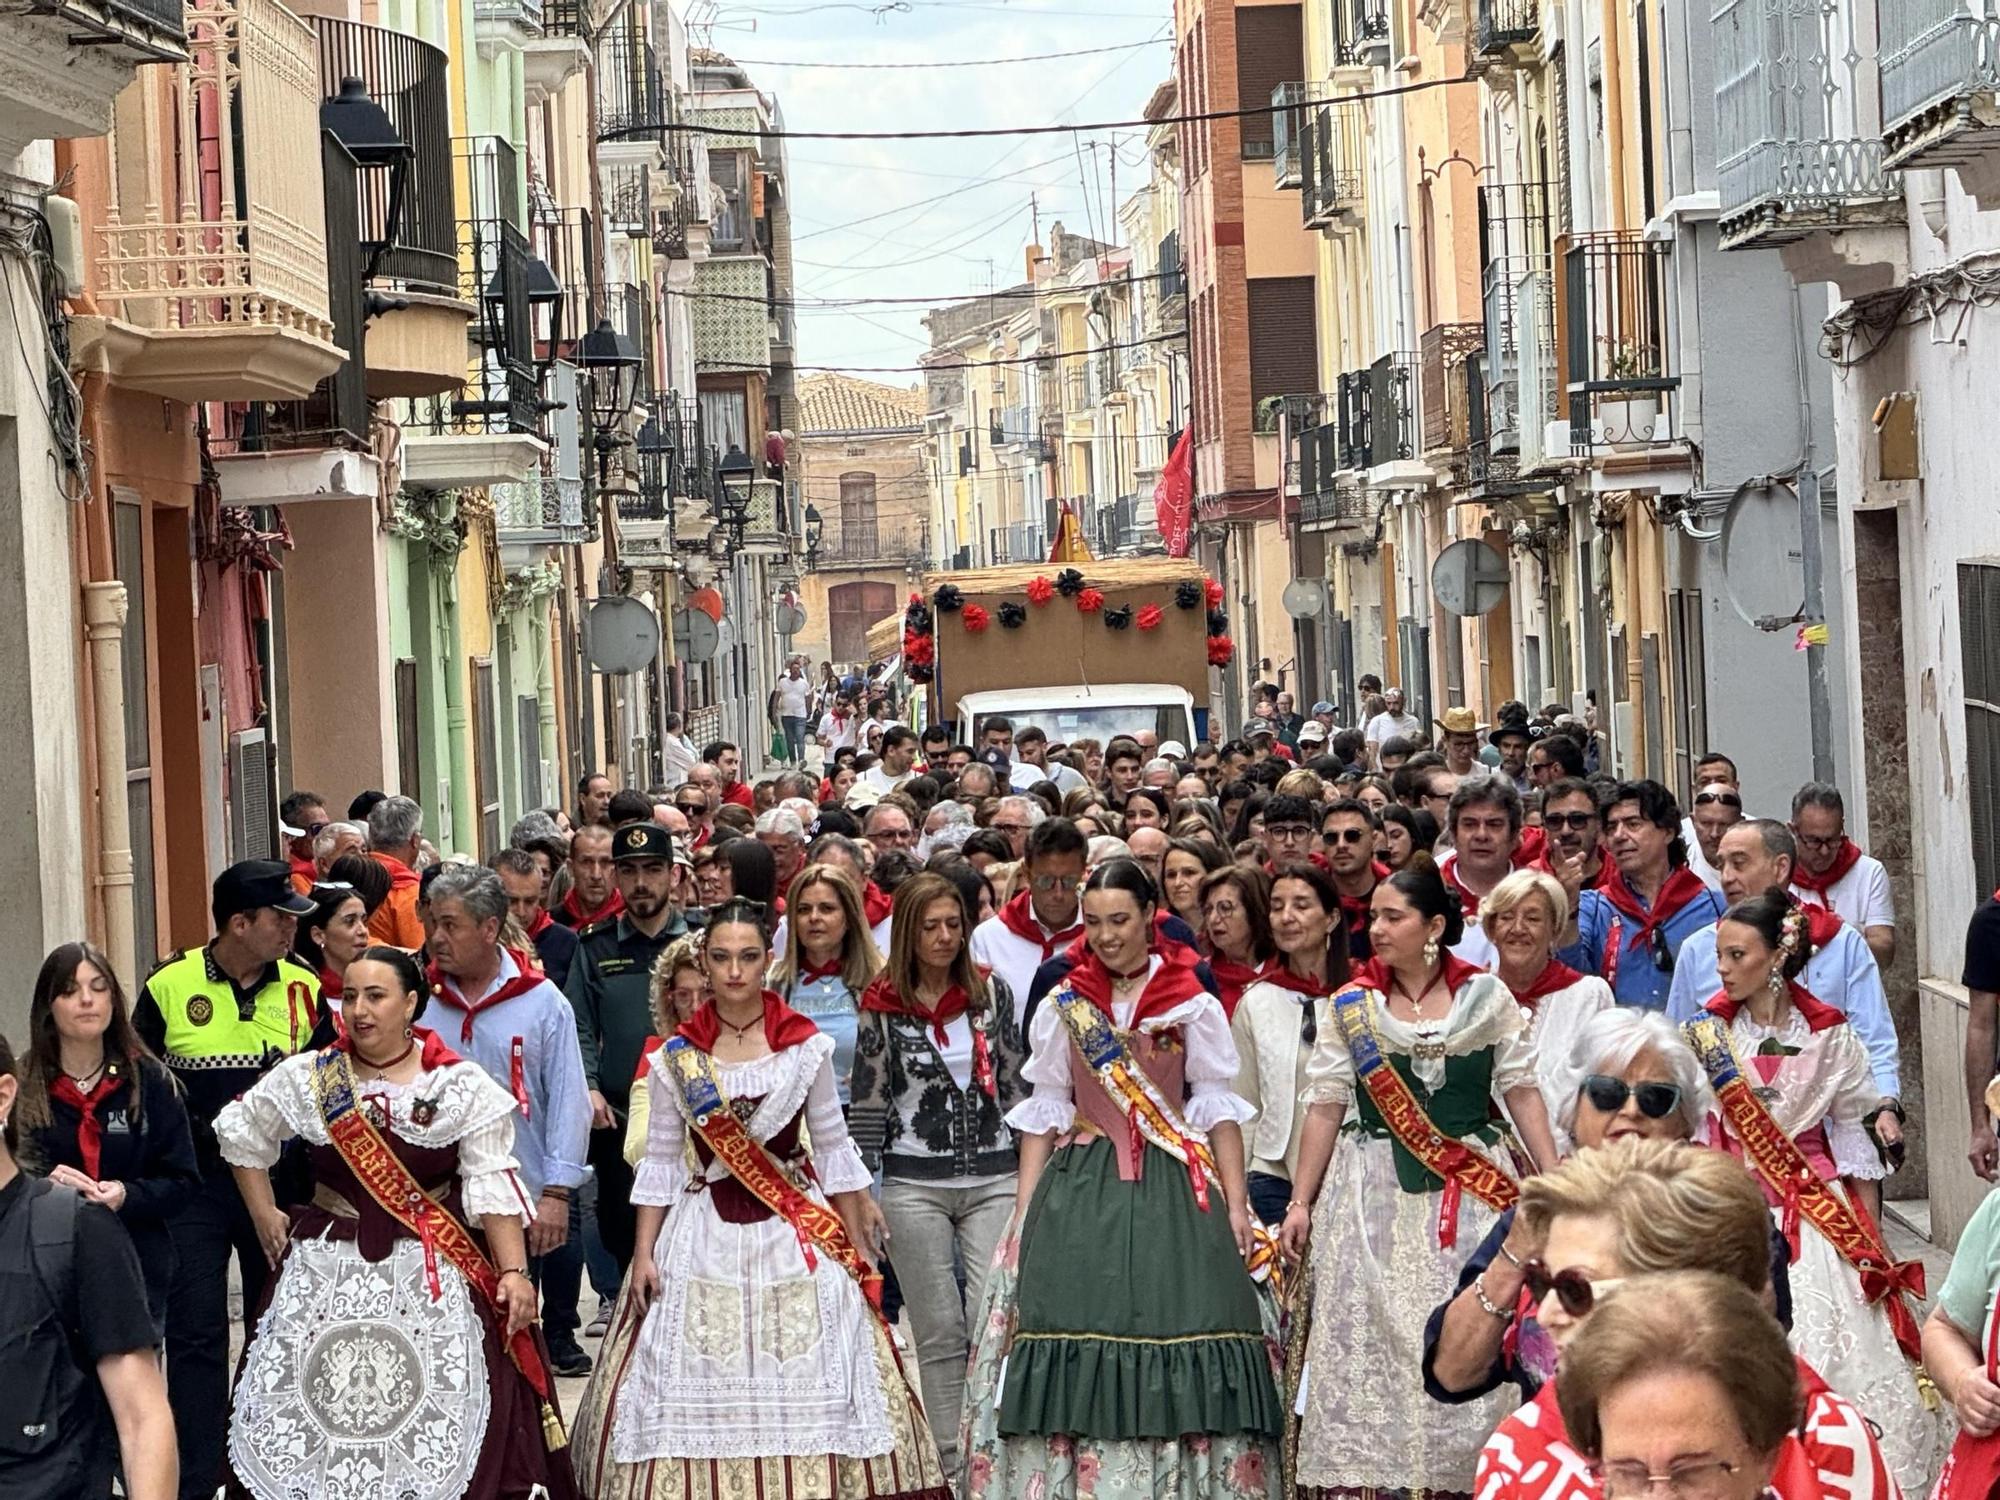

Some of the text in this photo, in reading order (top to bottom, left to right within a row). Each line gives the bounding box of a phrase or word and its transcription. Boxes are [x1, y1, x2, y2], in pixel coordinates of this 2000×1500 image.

[342, 1129, 409, 1211] Dama
[427, 1210, 484, 1273] 2024
[714, 1128, 784, 1203] Dama
[798, 1208, 856, 1266] 2024
[1376, 1083, 1448, 1162] Dama
[1456, 1159, 1521, 1206] 202
[1729, 1095, 1863, 1251] Dama 2024
